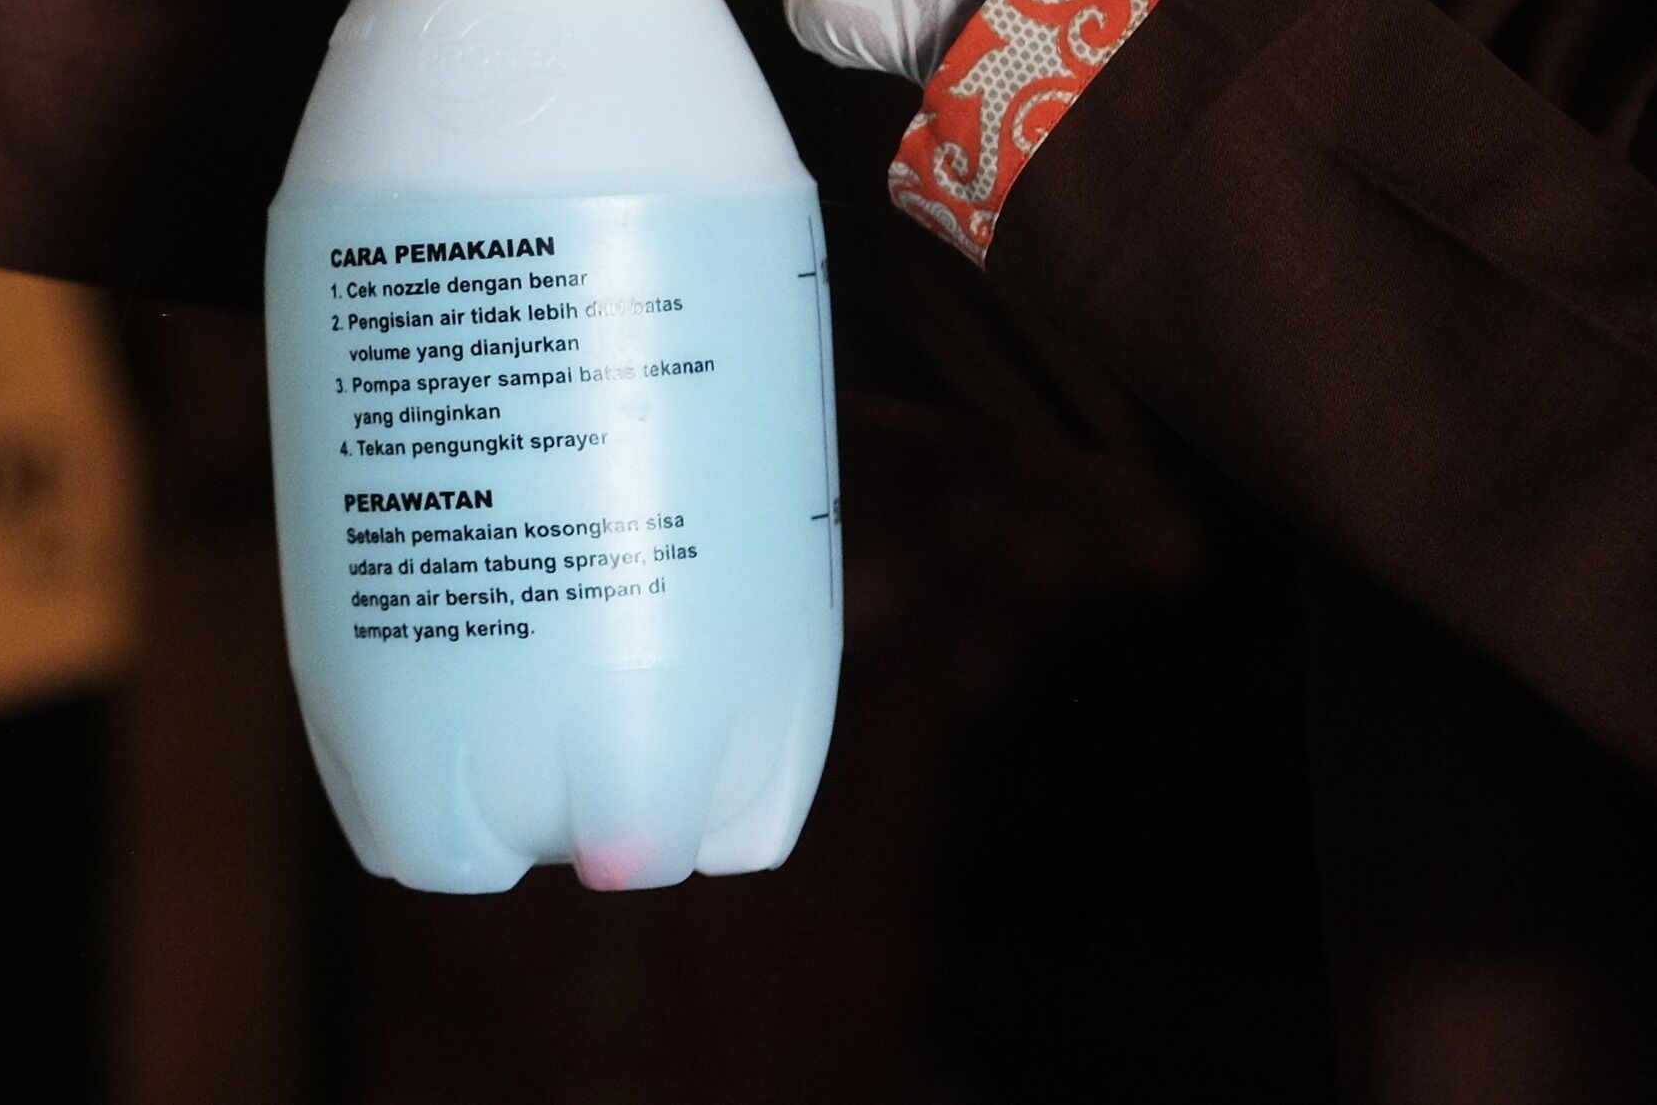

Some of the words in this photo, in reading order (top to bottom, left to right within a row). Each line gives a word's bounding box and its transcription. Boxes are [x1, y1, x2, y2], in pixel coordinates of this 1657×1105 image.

[330, 246, 387, 268] CARA
[395, 236, 555, 264] PEMAKAIAN
[330, 283, 343, 300] 1.
[346, 281, 377, 299] Cek
[383, 278, 441, 297] nozzle
[447, 276, 522, 296] dengan
[529, 272, 588, 289] benar
[348, 310, 434, 333] Pengisian
[440, 309, 465, 326] air
[471, 305, 522, 324] tidak
[528, 302, 579, 321] lebih
[349, 344, 411, 362] volume
[416, 344, 464, 363] yang
[470, 336, 580, 359] dianjurkan
[335, 377, 348, 394] 3.
[352, 376, 411, 395] Pompa
[417, 374, 491, 394] sprayer
[498, 366, 573, 388] sampai
[643, 358, 715, 378] tekanan
[354, 411, 393, 429] yang
[399, 403, 501, 426] diinginkan
[339, 441, 353, 457] 4.
[357, 440, 406, 456] Tekan
[412, 433, 524, 459] pengungkit
[530, 432, 608, 453] sprayer
[344, 489, 494, 513] PERAWATAN
[346, 526, 406, 544] Setelah
[411, 523, 518, 547] pemakaian
[524, 517, 639, 539] kosongkan
[646, 512, 685, 531] sisa
[349, 559, 393, 576] udara
[398, 558, 414, 575] di
[419, 557, 479, 575] dalam
[484, 554, 557, 574] tabung
[563, 550, 646, 571] sprayer,
[653, 544, 698, 562] bilas
[351, 590, 410, 612] dengan
[416, 589, 440, 607] air
[446, 587, 515, 606] bersih,
[521, 586, 559, 603] dan
[566, 583, 642, 602] simpan
[648, 577, 666, 595] di
[354, 623, 409, 643] tempat
[413, 622, 459, 643] yang
[466, 619, 535, 640] kering.
